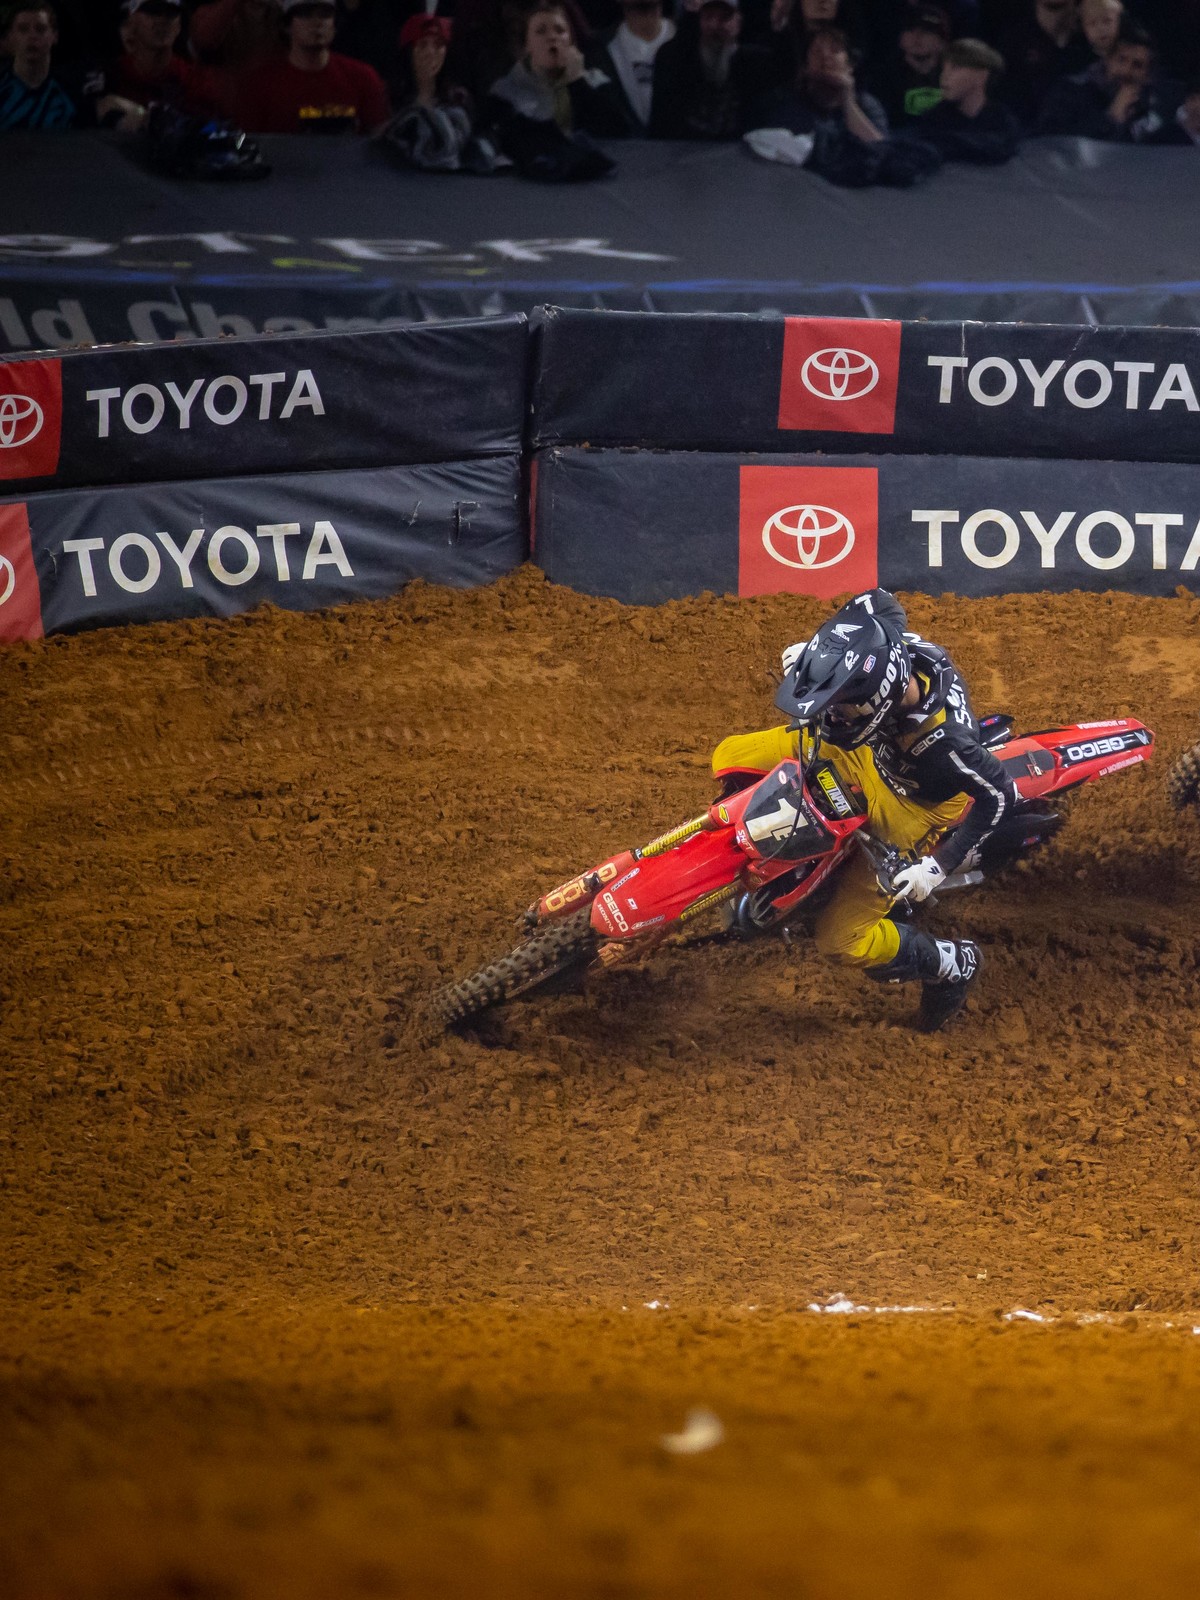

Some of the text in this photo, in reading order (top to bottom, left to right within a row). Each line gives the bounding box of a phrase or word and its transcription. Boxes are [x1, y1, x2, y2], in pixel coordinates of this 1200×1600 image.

[87, 370, 324, 437] TOYOTA
[928, 356, 1200, 413] TOYOTA
[63, 521, 354, 597] TOYOTA
[870, 641, 902, 706] 100%
[911, 728, 945, 756] GEICO
[1067, 737, 1126, 761] GEICO
[736, 829, 754, 850] SHIFT
[746, 798, 808, 842] 1
[545, 862, 618, 912] GICO
[597, 904, 614, 932] HONDA
[602, 892, 629, 933] GEICO
